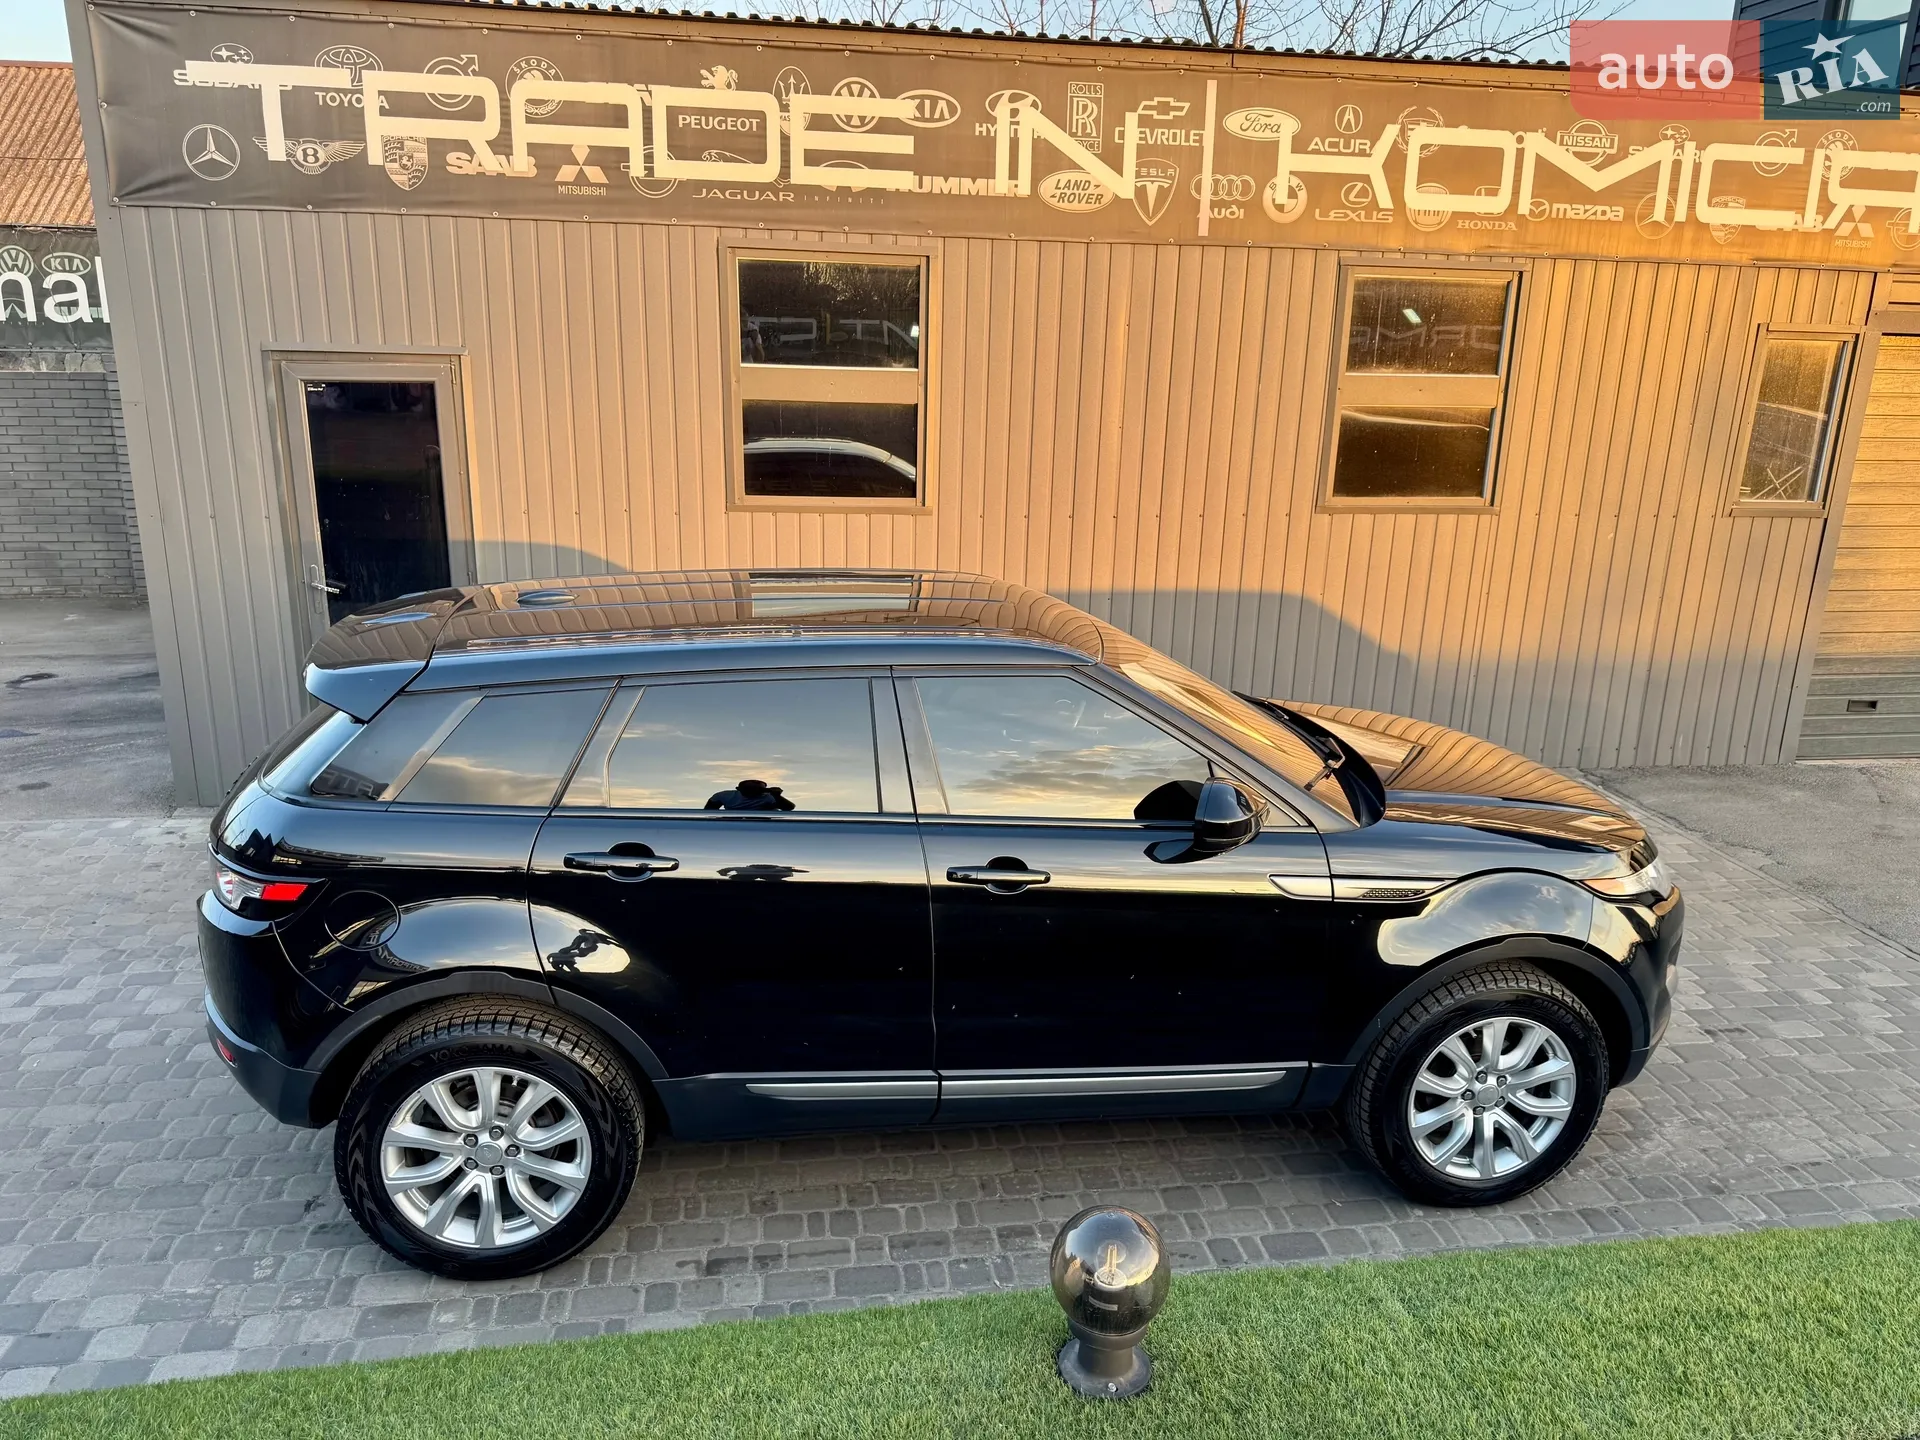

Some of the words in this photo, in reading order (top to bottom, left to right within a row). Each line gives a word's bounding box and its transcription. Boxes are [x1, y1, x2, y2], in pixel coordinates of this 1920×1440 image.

[512, 58, 557, 77] ŠKODA
[1071, 84, 1102, 95] ROLLS
[314, 91, 390, 110] TOYOA
[185, 60, 914, 189] TRADE
[995, 105, 1138, 199] IN
[678, 114, 761, 132] PEUGEOT
[1114, 126, 1207, 147] CEVROLE
[1563, 135, 1611, 148] NISSAN
[1077, 140, 1100, 151] OYCE
[1306, 136, 1374, 154] ACUR
[557, 185, 607, 196] MITSUBISHI
[1054, 178, 1092, 192] LAND
[692, 188, 795, 202] JAGUAR
[1056, 192, 1105, 206] ROVER
[1314, 208, 1394, 224] LEXUS
[1456, 219, 1518, 231] HONDA
